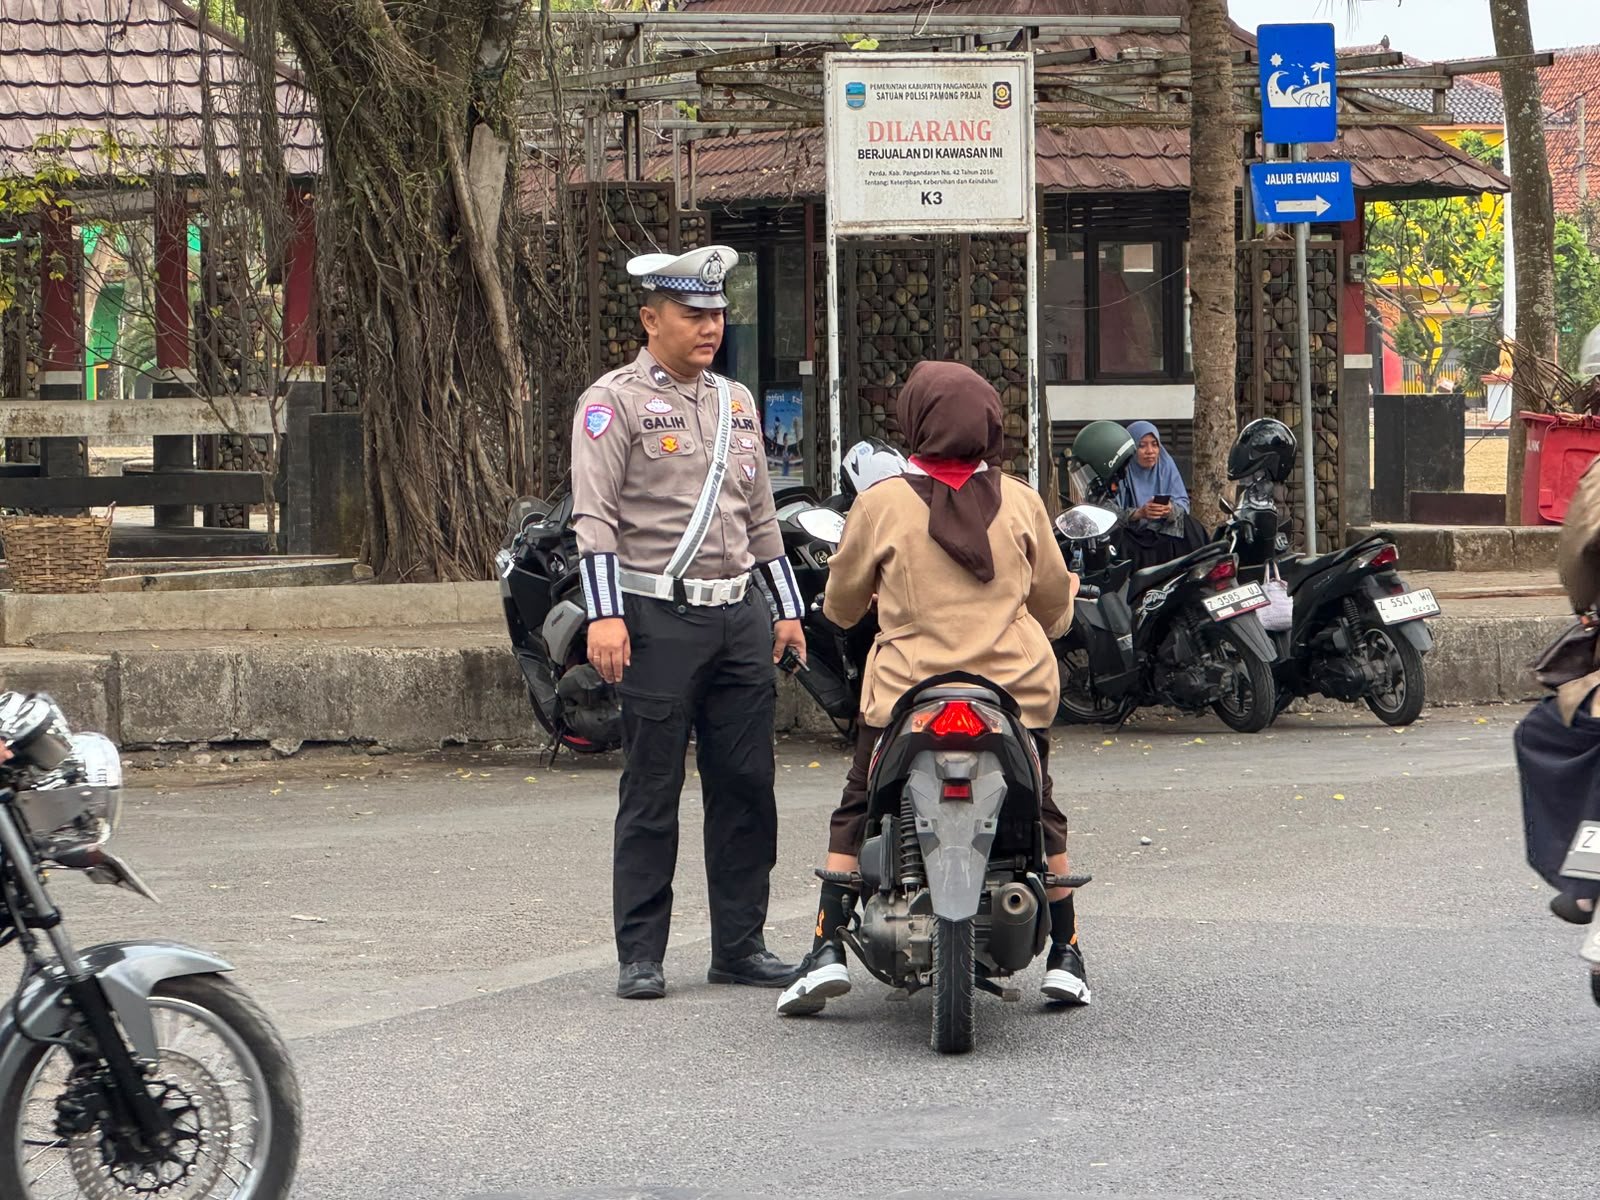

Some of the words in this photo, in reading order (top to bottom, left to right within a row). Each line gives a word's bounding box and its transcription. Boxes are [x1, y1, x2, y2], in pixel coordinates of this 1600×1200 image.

[876, 92, 903, 100] SATUAN
[905, 92, 928, 100] POLISI
[930, 91, 958, 100] PAMONG
[960, 91, 982, 99] PRAJA
[868, 120, 992, 143] DILARANG
[858, 148, 920, 159] BERJUALAN
[922, 148, 934, 159] DI
[935, 148, 988, 159] KAWASAN
[990, 147, 1003, 159] INI
[1265, 173, 1293, 185] JALUR
[1296, 172, 1339, 184] EVAKUASI
[921, 191, 943, 205] K3
[643, 416, 685, 429] GALIH
[731, 418, 755, 431] OLRI
[1207, 600, 1214, 609] Z
[1247, 586, 1260, 595] UJ
[1378, 601, 1386, 610] Z
[1391, 595, 1412, 607] 5541
[1419, 591, 1432, 602] WH
[1582, 830, 1596, 848] Z
